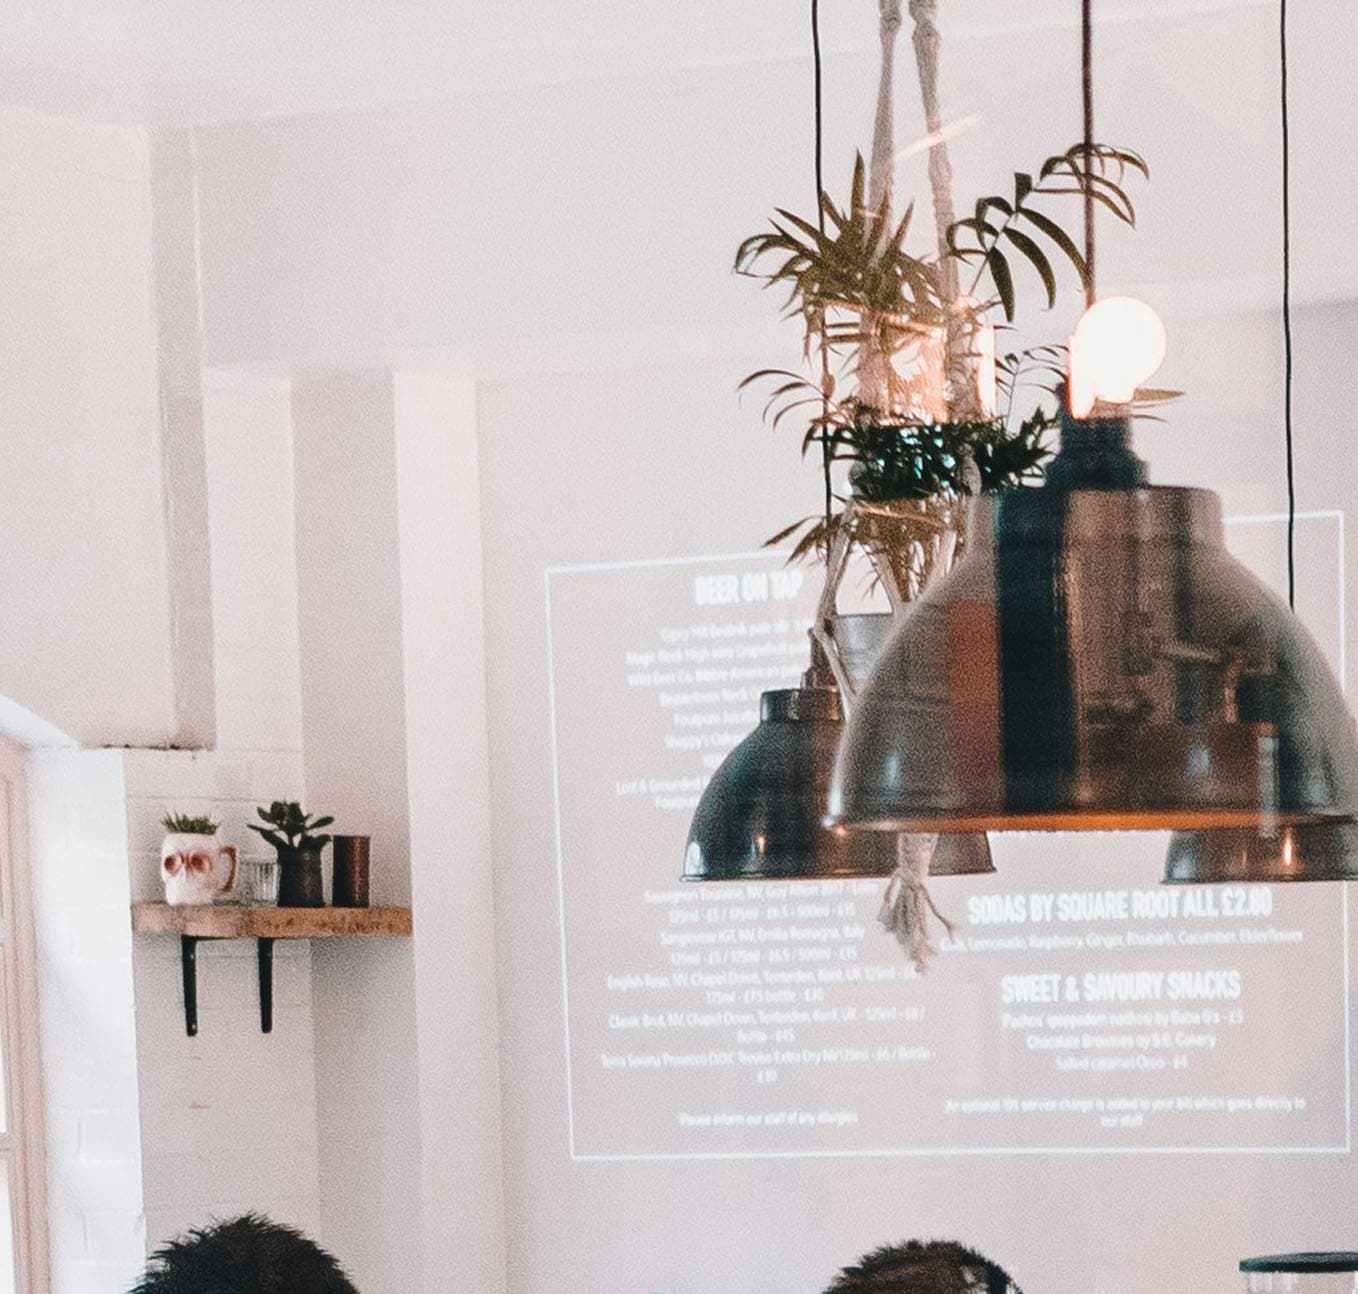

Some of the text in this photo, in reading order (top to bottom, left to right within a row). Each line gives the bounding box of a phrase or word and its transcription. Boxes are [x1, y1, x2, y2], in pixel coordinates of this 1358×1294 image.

[695, 573, 739, 605] BEER
[742, 571, 768, 601] ON
[968, 894, 1027, 924] SODAS
[1030, 893, 1054, 922] BY
[1057, 890, 1128, 921] SQUARE
[1132, 889, 1179, 918] ROOT
[1183, 886, 1219, 917] ALL
[1001, 969, 1241, 1003] SWEET & SAVOURY SNACKS
